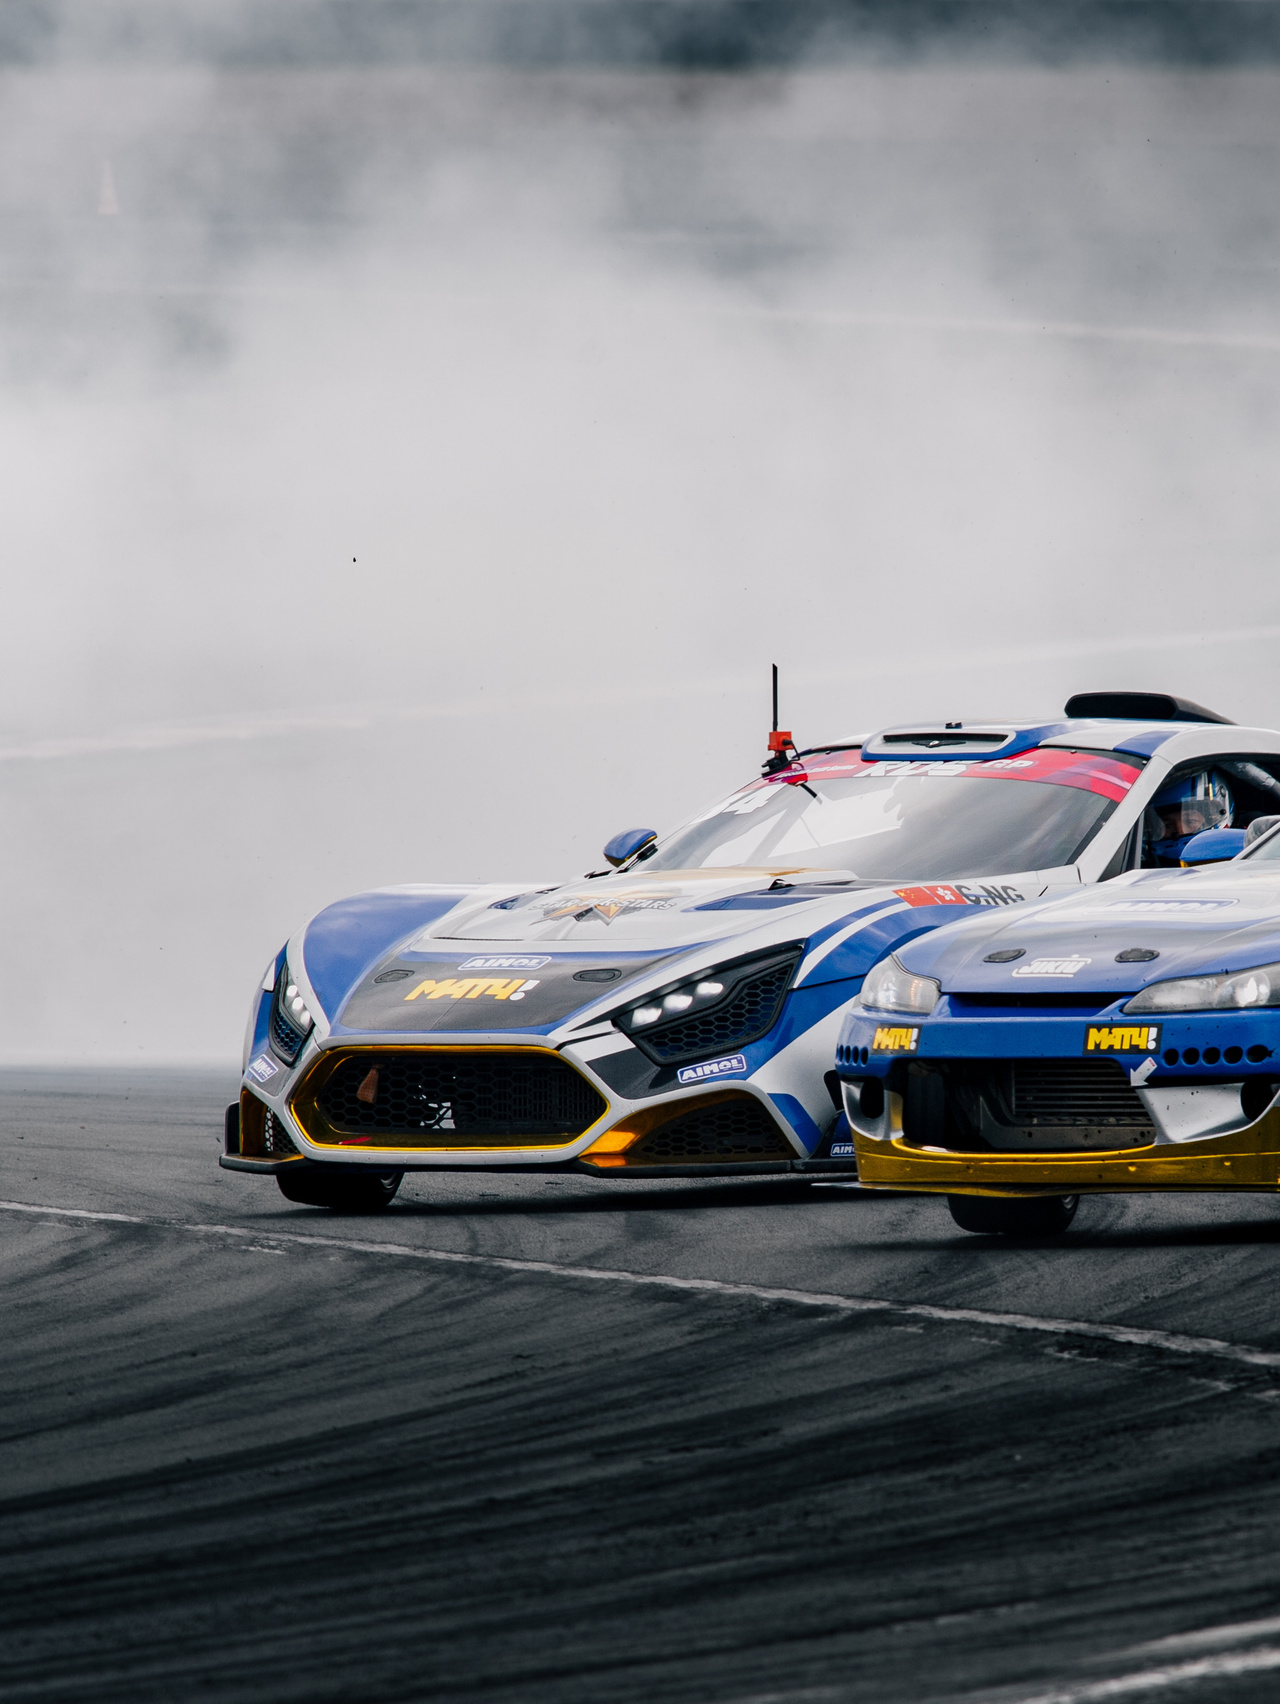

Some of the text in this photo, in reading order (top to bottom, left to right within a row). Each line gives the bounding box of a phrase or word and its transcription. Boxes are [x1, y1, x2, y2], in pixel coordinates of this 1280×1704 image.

[469, 958, 541, 968] AIMOL
[681, 1058, 743, 1080] AIMOL
[832, 1145, 855, 1154] AIM
